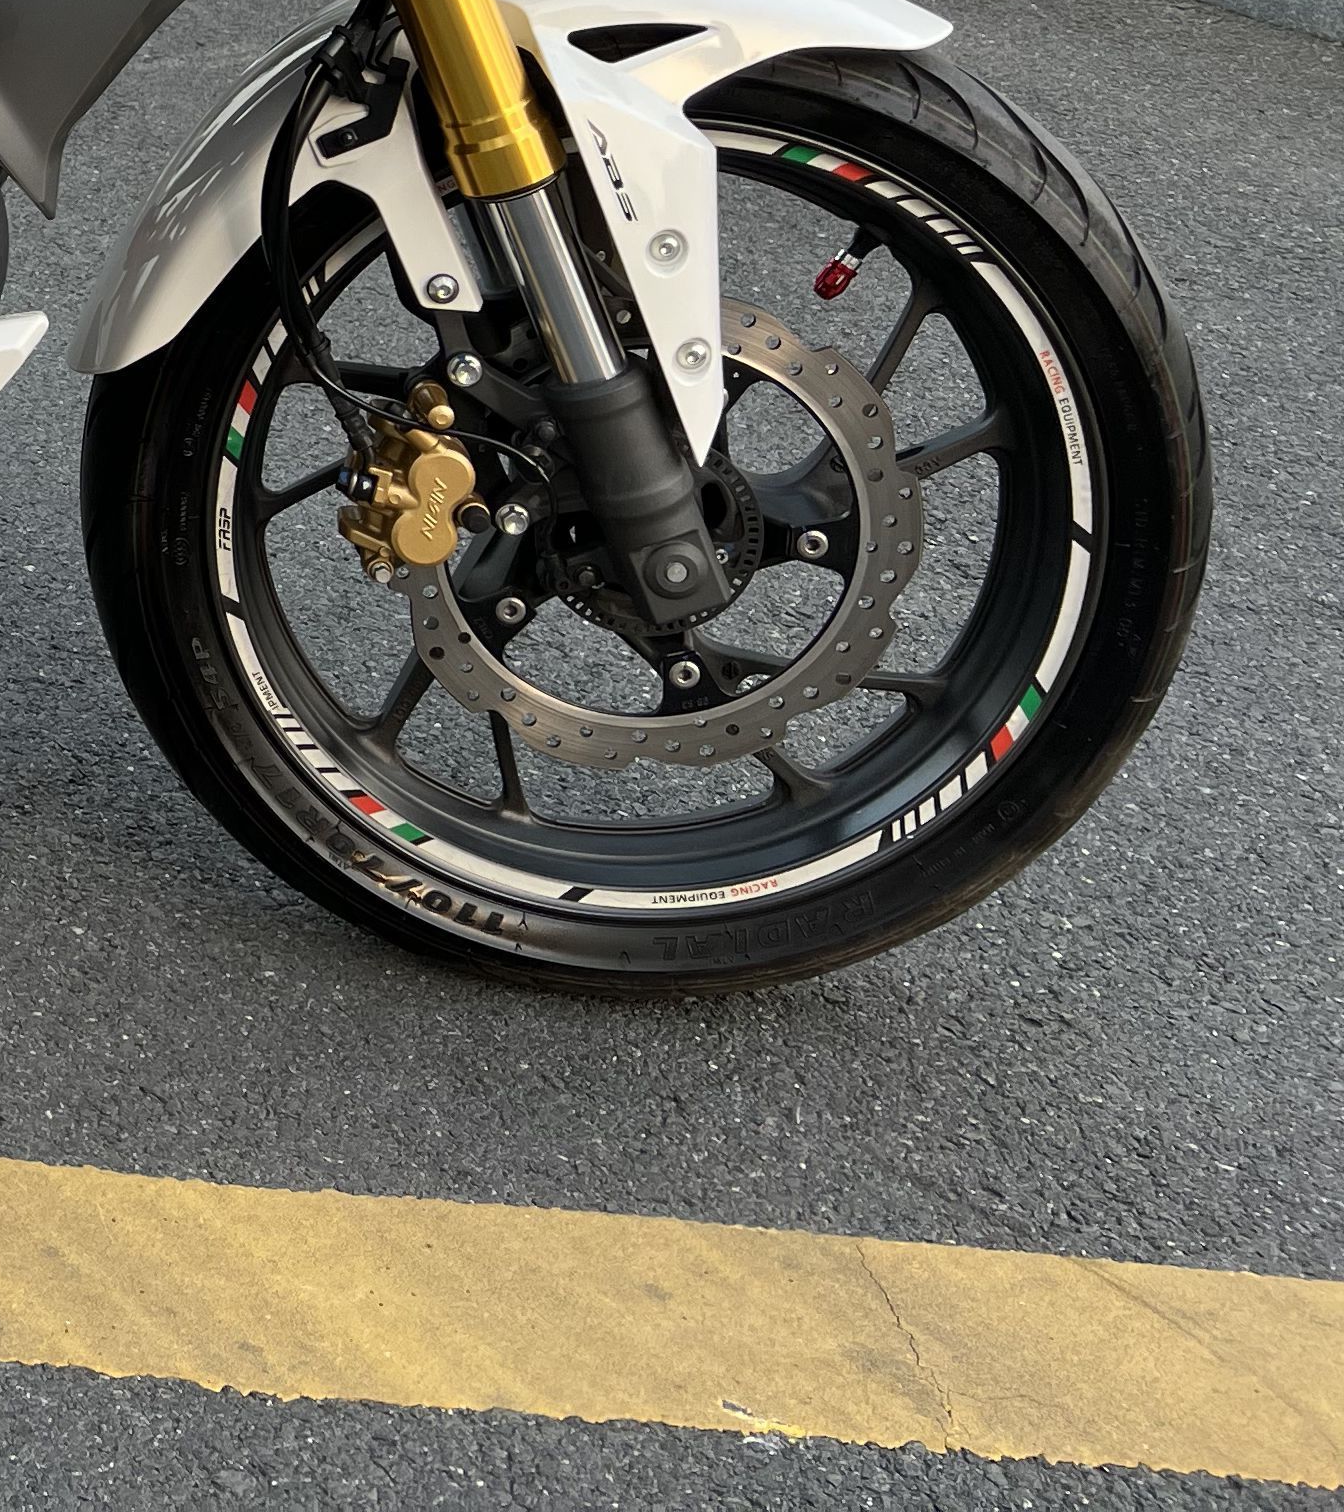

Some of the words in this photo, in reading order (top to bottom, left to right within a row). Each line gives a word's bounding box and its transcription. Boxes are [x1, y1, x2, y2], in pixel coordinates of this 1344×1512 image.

[1039, 349, 1066, 395] RACING
[1058, 396, 1084, 467] EQUIPMENT
[651, 889, 726, 906] EQUIPMENT
[732, 878, 778, 898] RACING
